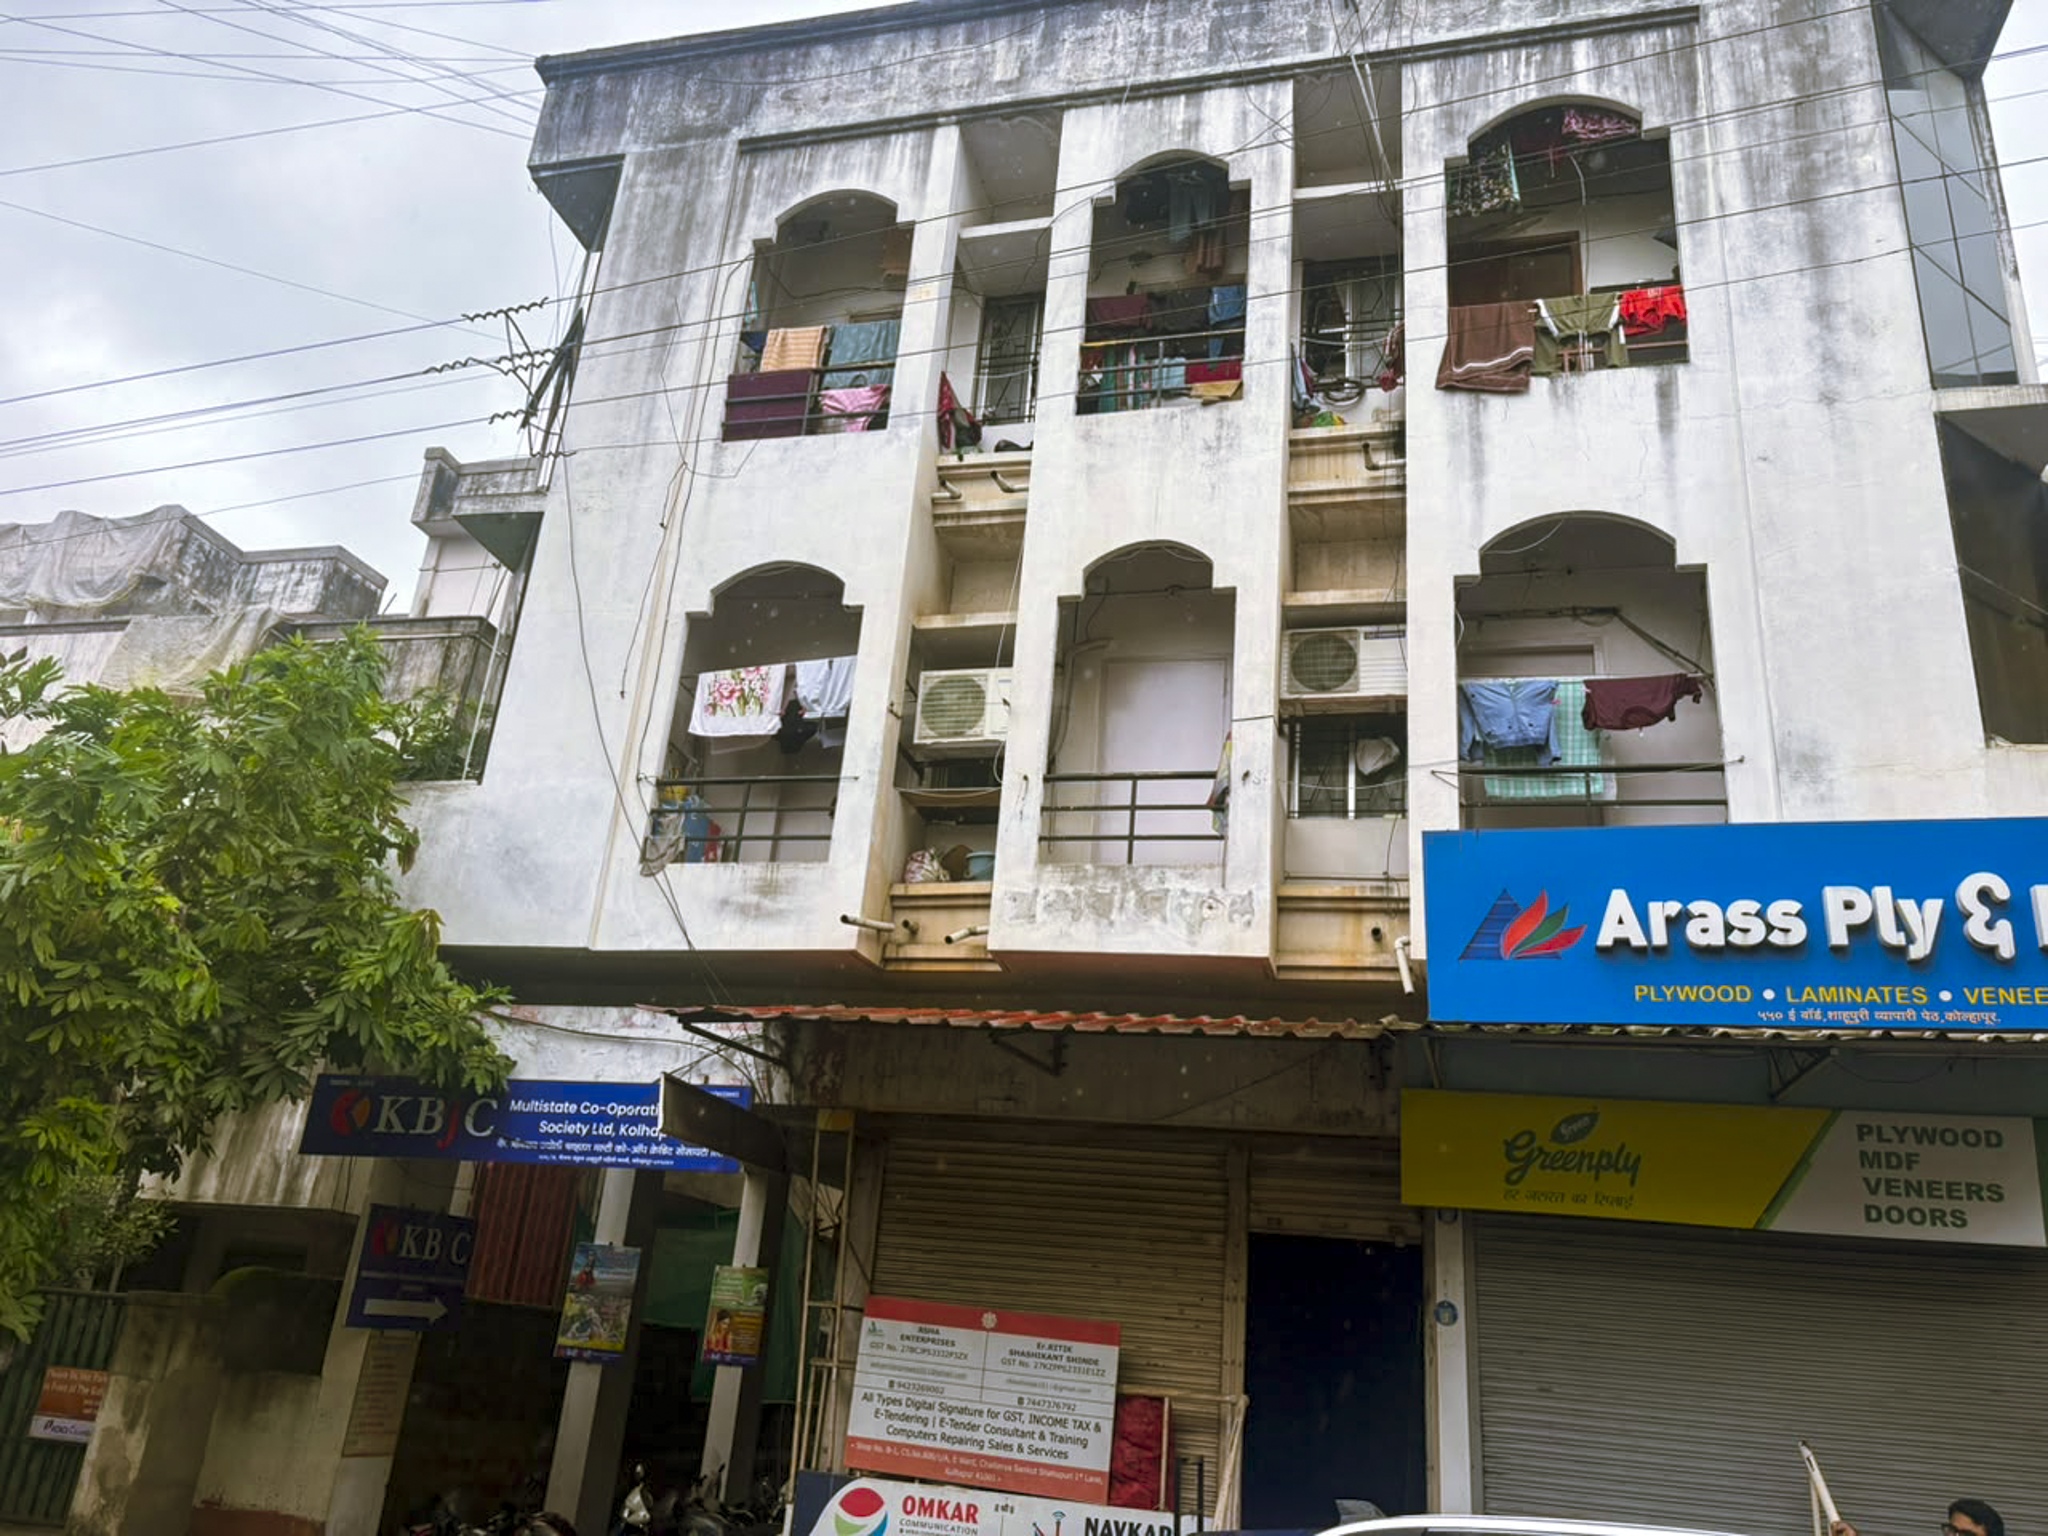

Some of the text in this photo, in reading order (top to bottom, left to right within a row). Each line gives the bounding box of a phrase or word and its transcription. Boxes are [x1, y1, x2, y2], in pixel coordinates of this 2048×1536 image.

[1596, 889, 1808, 949] Arass
[1823, 886, 1944, 962] Ply
[1957, 872, 2015, 961] &
[1634, 984, 1753, 1004] PLYWOOD
[1785, 986, 1929, 1006] LAMINATES
[510, 1099, 577, 1115] Multistate
[539, 1120, 588, 1137] Society
[592, 1121, 616, 1138] Ltd,
[1856, 1124, 2004, 1148] PLYWOOD
[1503, 1129, 1642, 1187] Greenply
[1859, 1150, 1921, 1171] MDF
[1863, 1177, 2005, 1203] VENEERS
[1864, 1204, 1969, 1228] DOORS
[900, 1334, 956, 1348] ENTERPRISES
[1001, 1357, 1016, 1366] GST
[1009, 1348, 1100, 1366] SHASHIKANT SHINDE
[861, 1391, 1102, 1434] All Types Digital Signature for GST, INCOME TAX &
[873, 1408, 929, 1428] E-Tendering
[939, 1418, 981, 1434] E-Tender
[983, 1424, 1036, 1441] Consultant
[1038, 1430, 1046, 1442] &
[1049, 1430, 1089, 1449] Training
[885, 1424, 1069, 1460] Computers Repairing Sales & Services
[902, 1494, 979, 1525] OMKAR
[899, 1517, 979, 1536] COMMUNICATION
